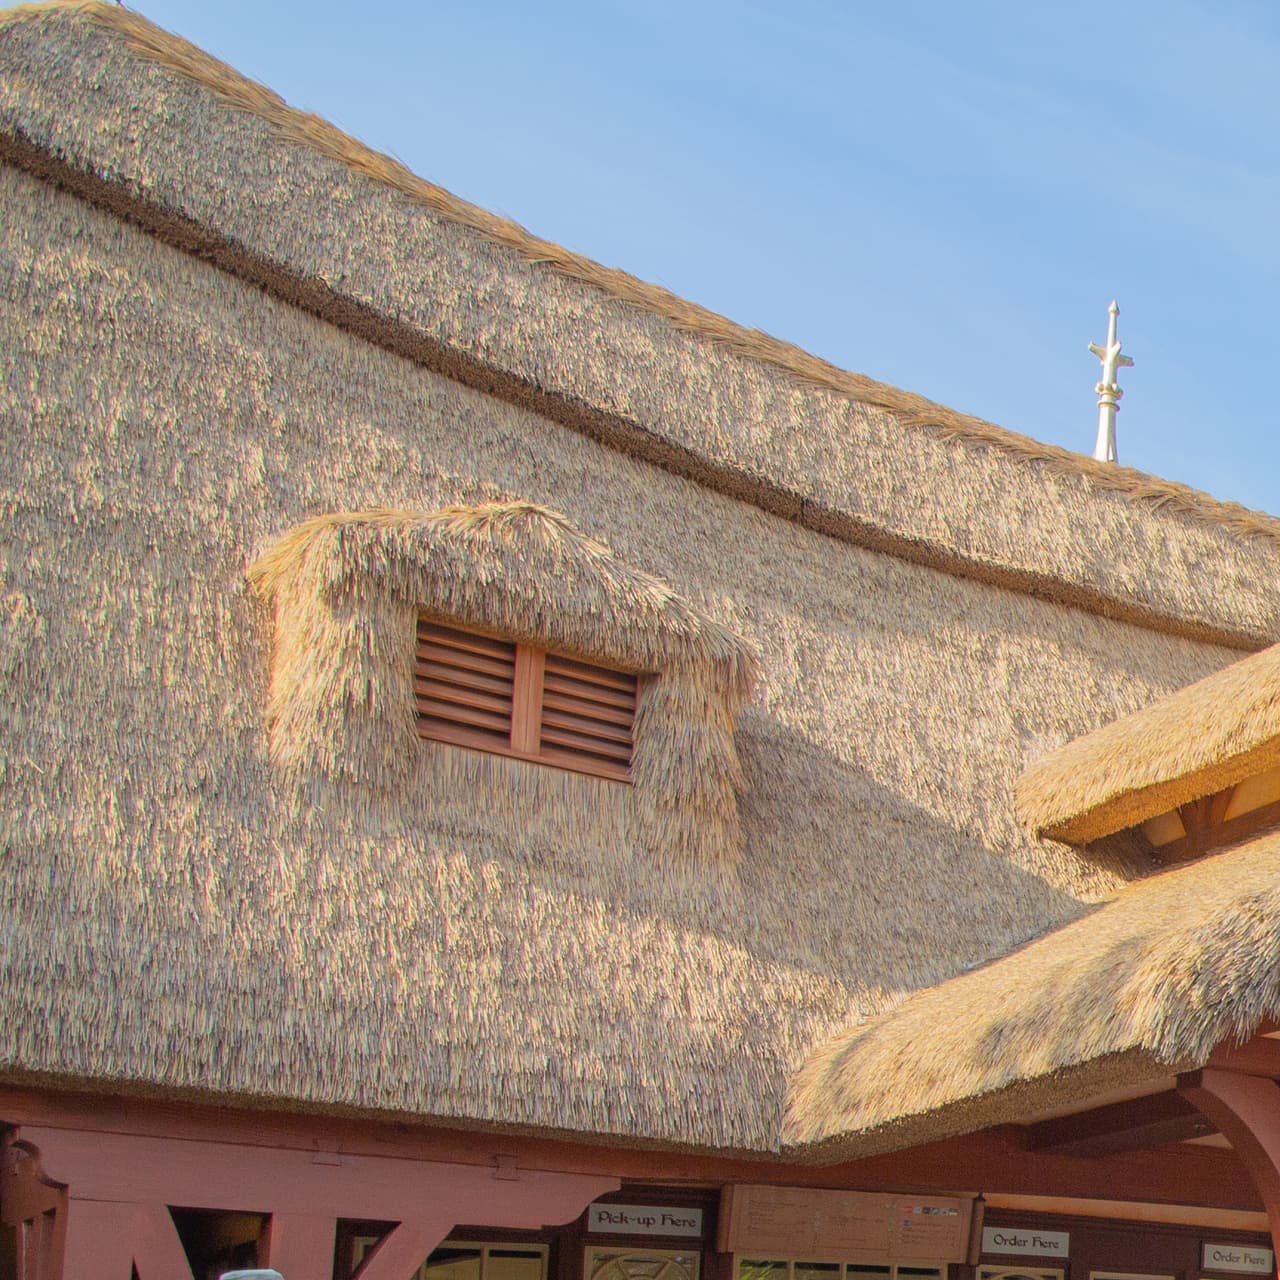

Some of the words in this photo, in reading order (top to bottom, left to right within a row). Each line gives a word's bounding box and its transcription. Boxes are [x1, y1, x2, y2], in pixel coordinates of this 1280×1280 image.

[598, 1210, 656, 1228] Pick-up
[661, 1213, 697, 1228] Here
[993, 1233, 1029, 1248] Order
[1032, 1236, 1060, 1249] Here
[1212, 1250, 1241, 1263] Order
